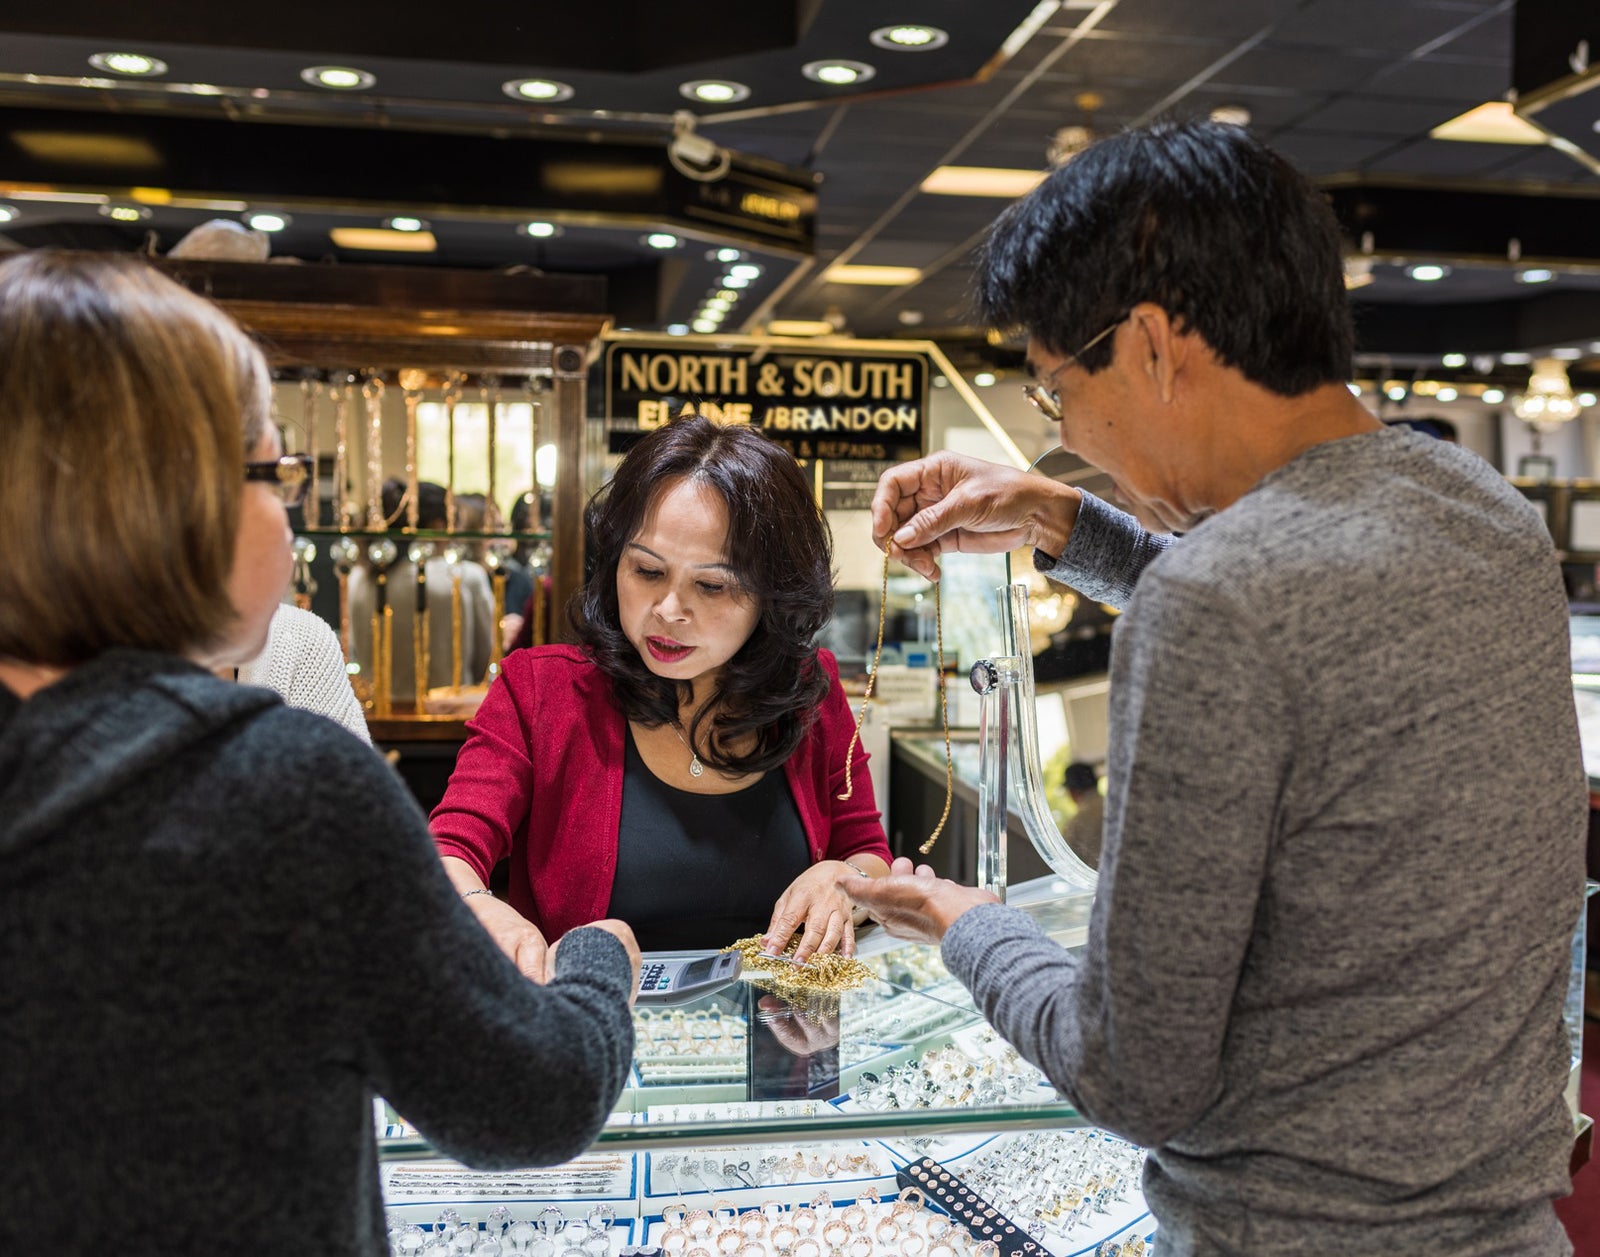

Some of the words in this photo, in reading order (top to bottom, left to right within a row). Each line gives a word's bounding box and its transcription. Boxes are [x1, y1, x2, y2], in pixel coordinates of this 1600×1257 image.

[621, 353, 748, 395] NORTH
[756, 363, 785, 397] &
[793, 361, 914, 400] SOUTH
[817, 441, 886, 459] REPAIRS
